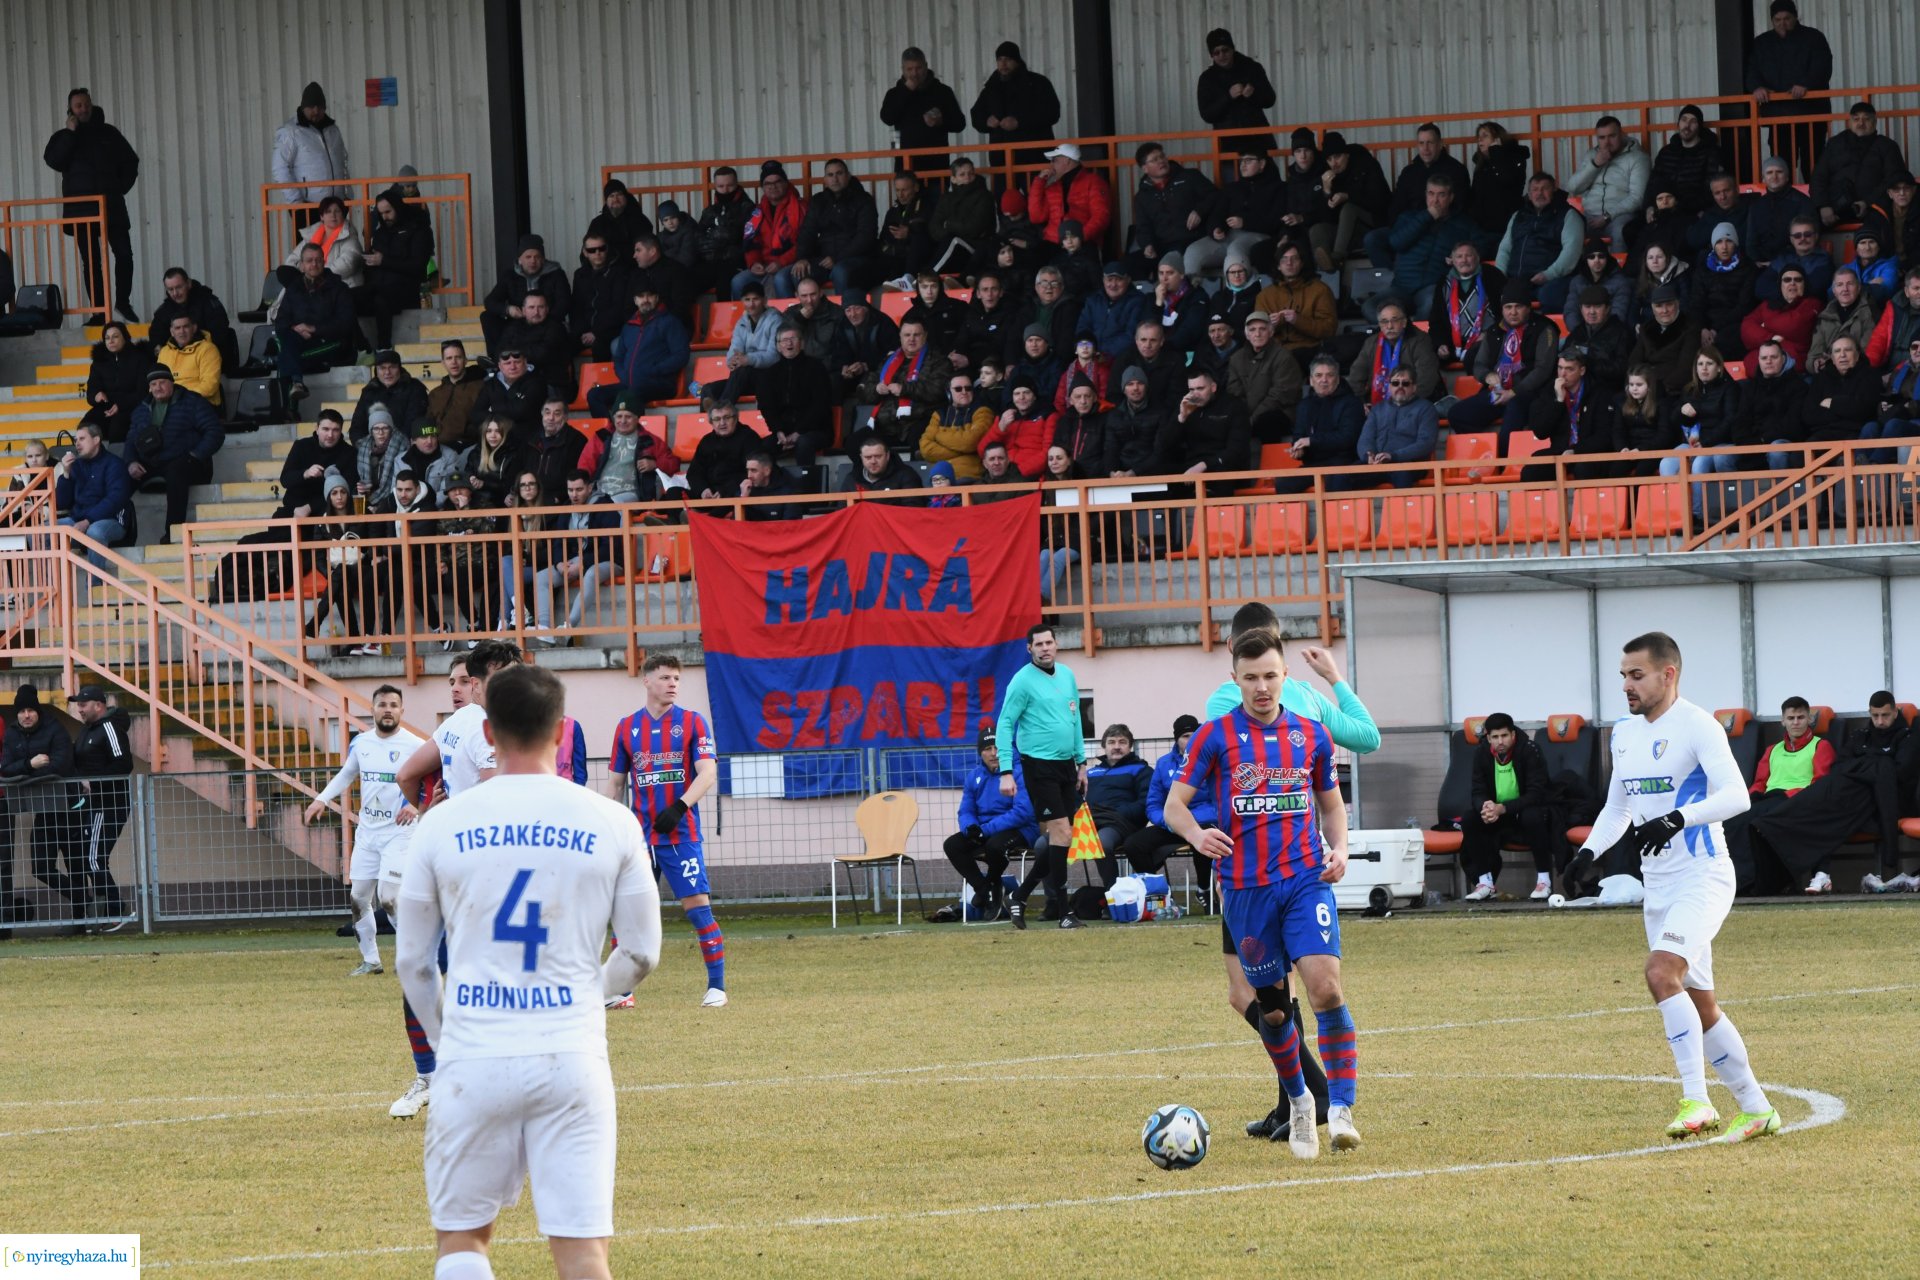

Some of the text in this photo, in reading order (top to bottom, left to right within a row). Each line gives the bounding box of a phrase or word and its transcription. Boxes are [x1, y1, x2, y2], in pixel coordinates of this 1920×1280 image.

[764, 538, 974, 624] HAJRÁ
[756, 676, 996, 749] SZPARI!
[455, 820, 597, 855] TISZAKÉCSKE
[680, 857, 700, 878] 23
[492, 868, 549, 972] 4
[1315, 902, 1332, 927] 6
[457, 981, 574, 1010] GRÜNVALD
